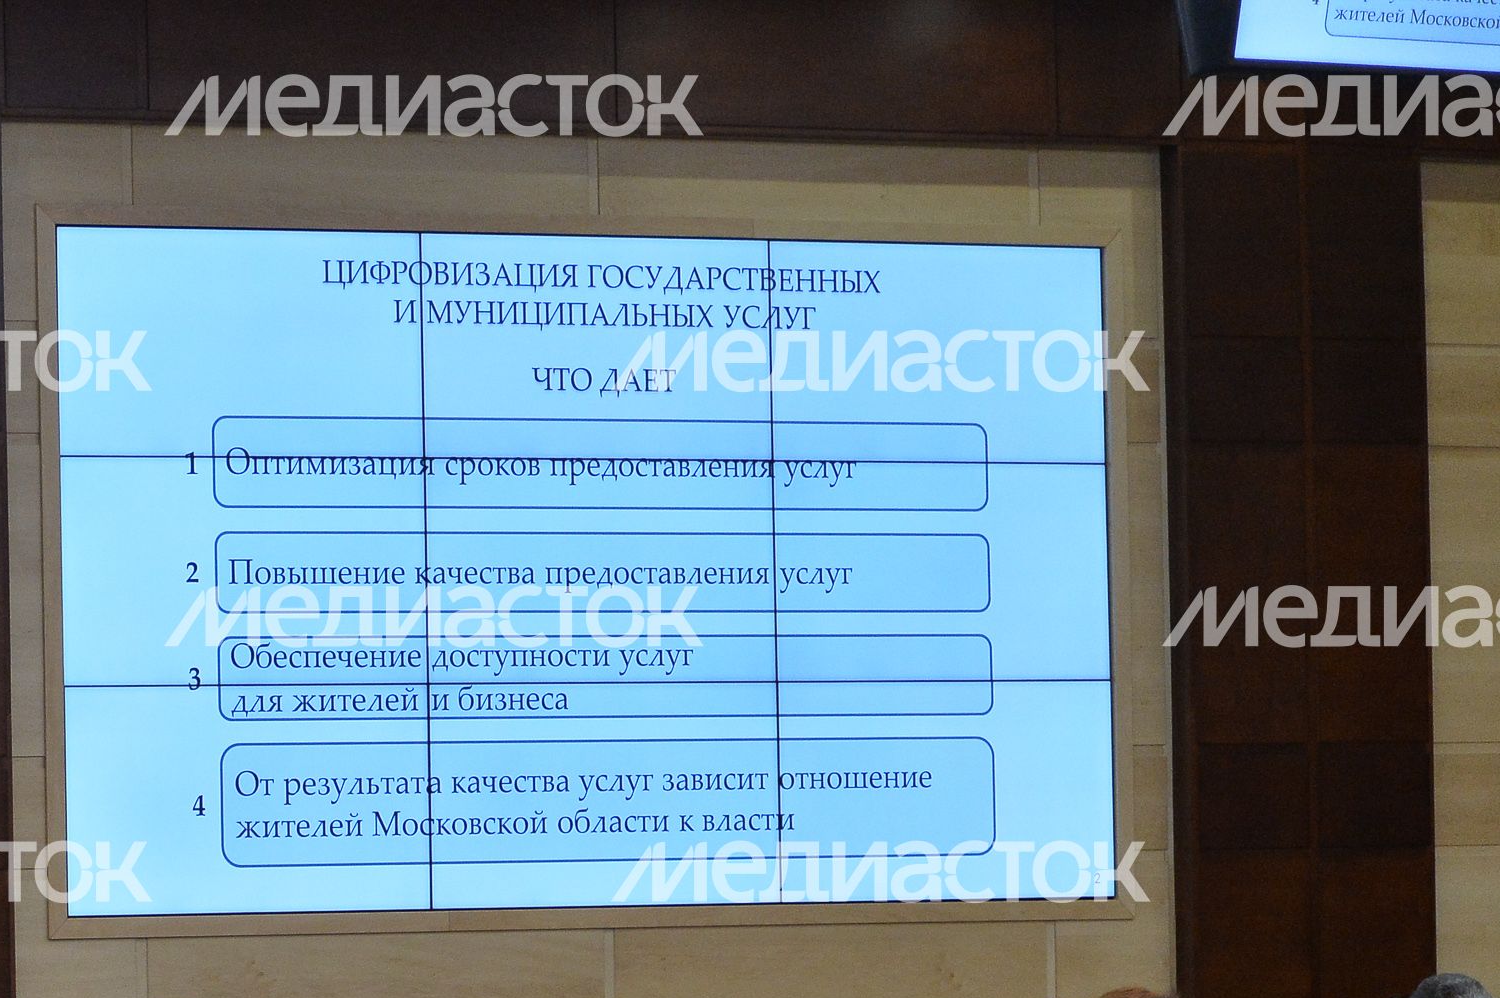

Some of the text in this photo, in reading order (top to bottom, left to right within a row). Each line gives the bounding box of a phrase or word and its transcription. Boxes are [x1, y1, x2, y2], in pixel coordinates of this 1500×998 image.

[1335, 8, 1404, 24] жителей
[322, 259, 881, 295] ЦИФРОВИЗАЦИЯ ГОСУДАРСТВЕННЫХ
[393, 301, 816, 330] И МУНИЦИПАЛЬНЫХ УСЛУГ
[532, 367, 677, 397] ЧТО ДАЕТ
[185, 452, 199, 475] 1
[225, 447, 857, 487] Оптимизация сроков предоставления услуг
[186, 563, 199, 583] 2
[228, 559, 853, 593] Повышение качества предоставления услуг
[230, 642, 694, 676] Обеспечение доступности услуг
[188, 667, 201, 691] 3
[231, 685, 569, 716] для жителей и бизнеса
[234, 767, 933, 805] От результата качества услуг зависит отношение
[192, 795, 206, 817] 4
[236, 806, 795, 839] жителей Московской области к власти
